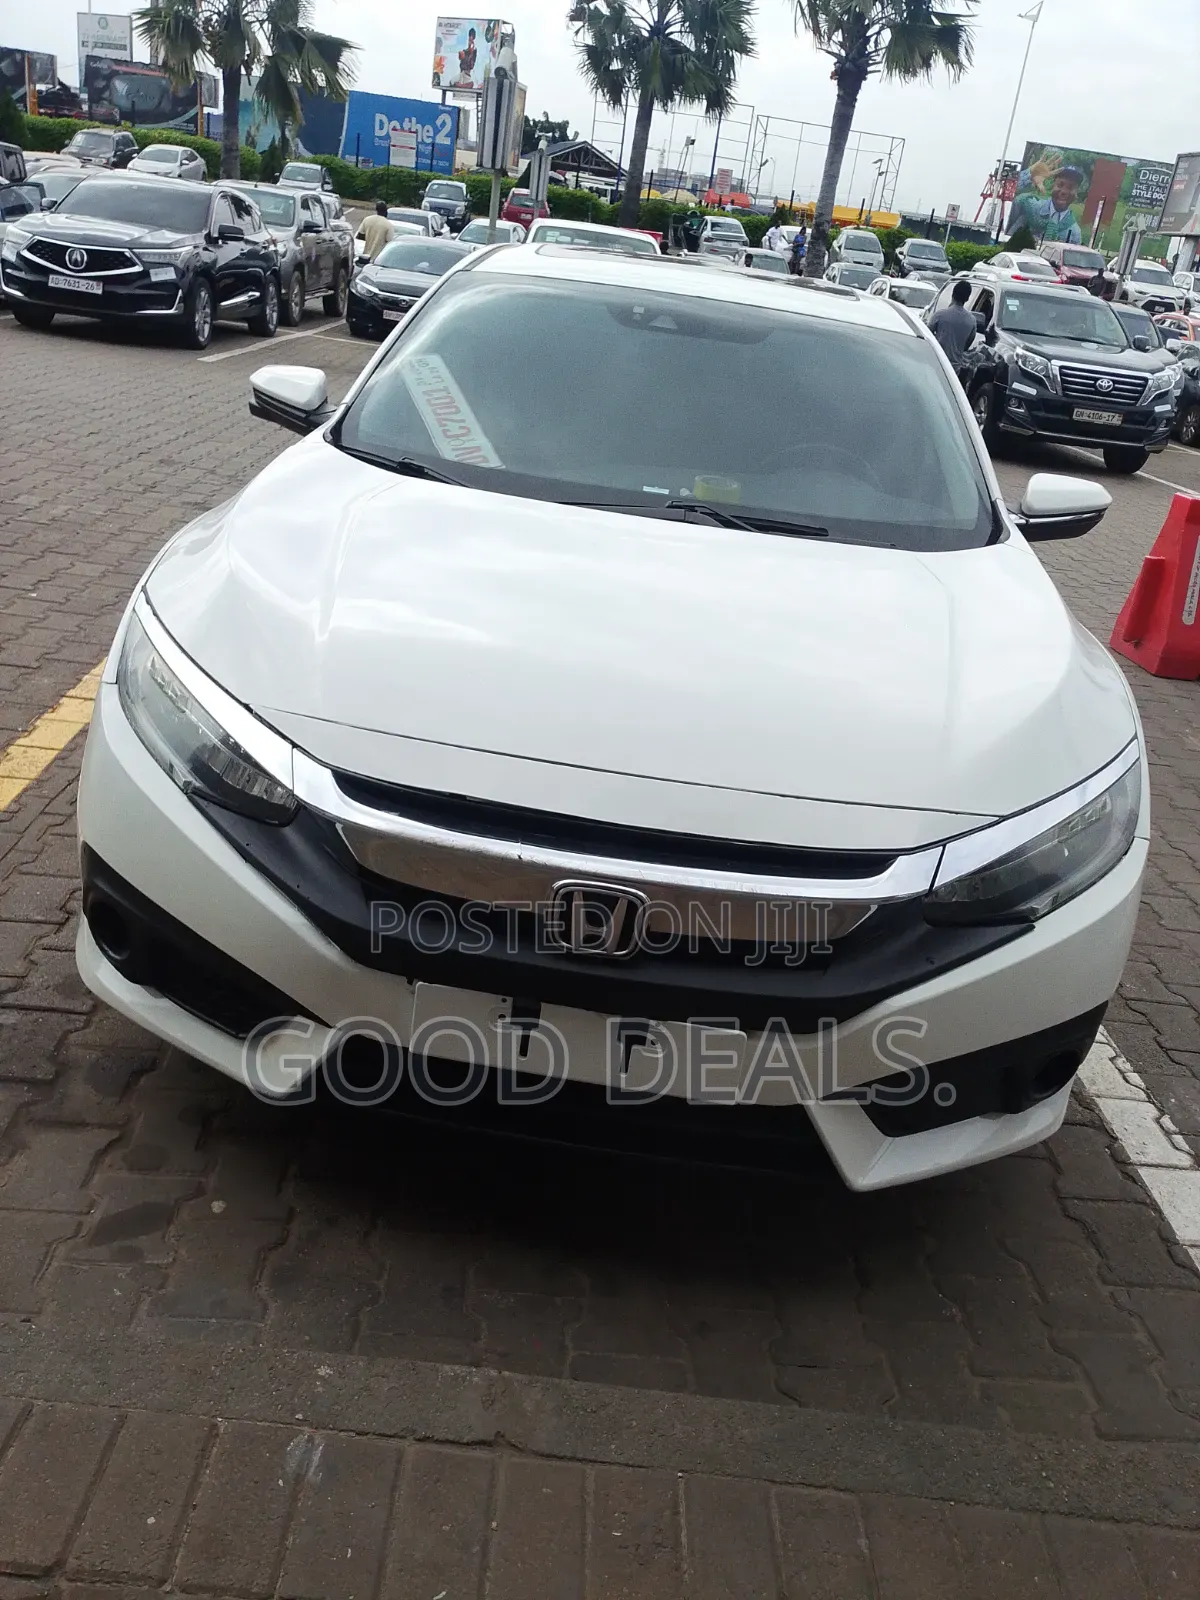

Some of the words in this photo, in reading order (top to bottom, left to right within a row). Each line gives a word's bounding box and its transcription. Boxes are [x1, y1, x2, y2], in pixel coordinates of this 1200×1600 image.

[403, 117, 433, 144] the
[435, 113, 452, 144] 2
[1140, 170, 1171, 183] Dierr
[1133, 183, 1148, 191] THE
[1132, 189, 1152, 198] STYLE
